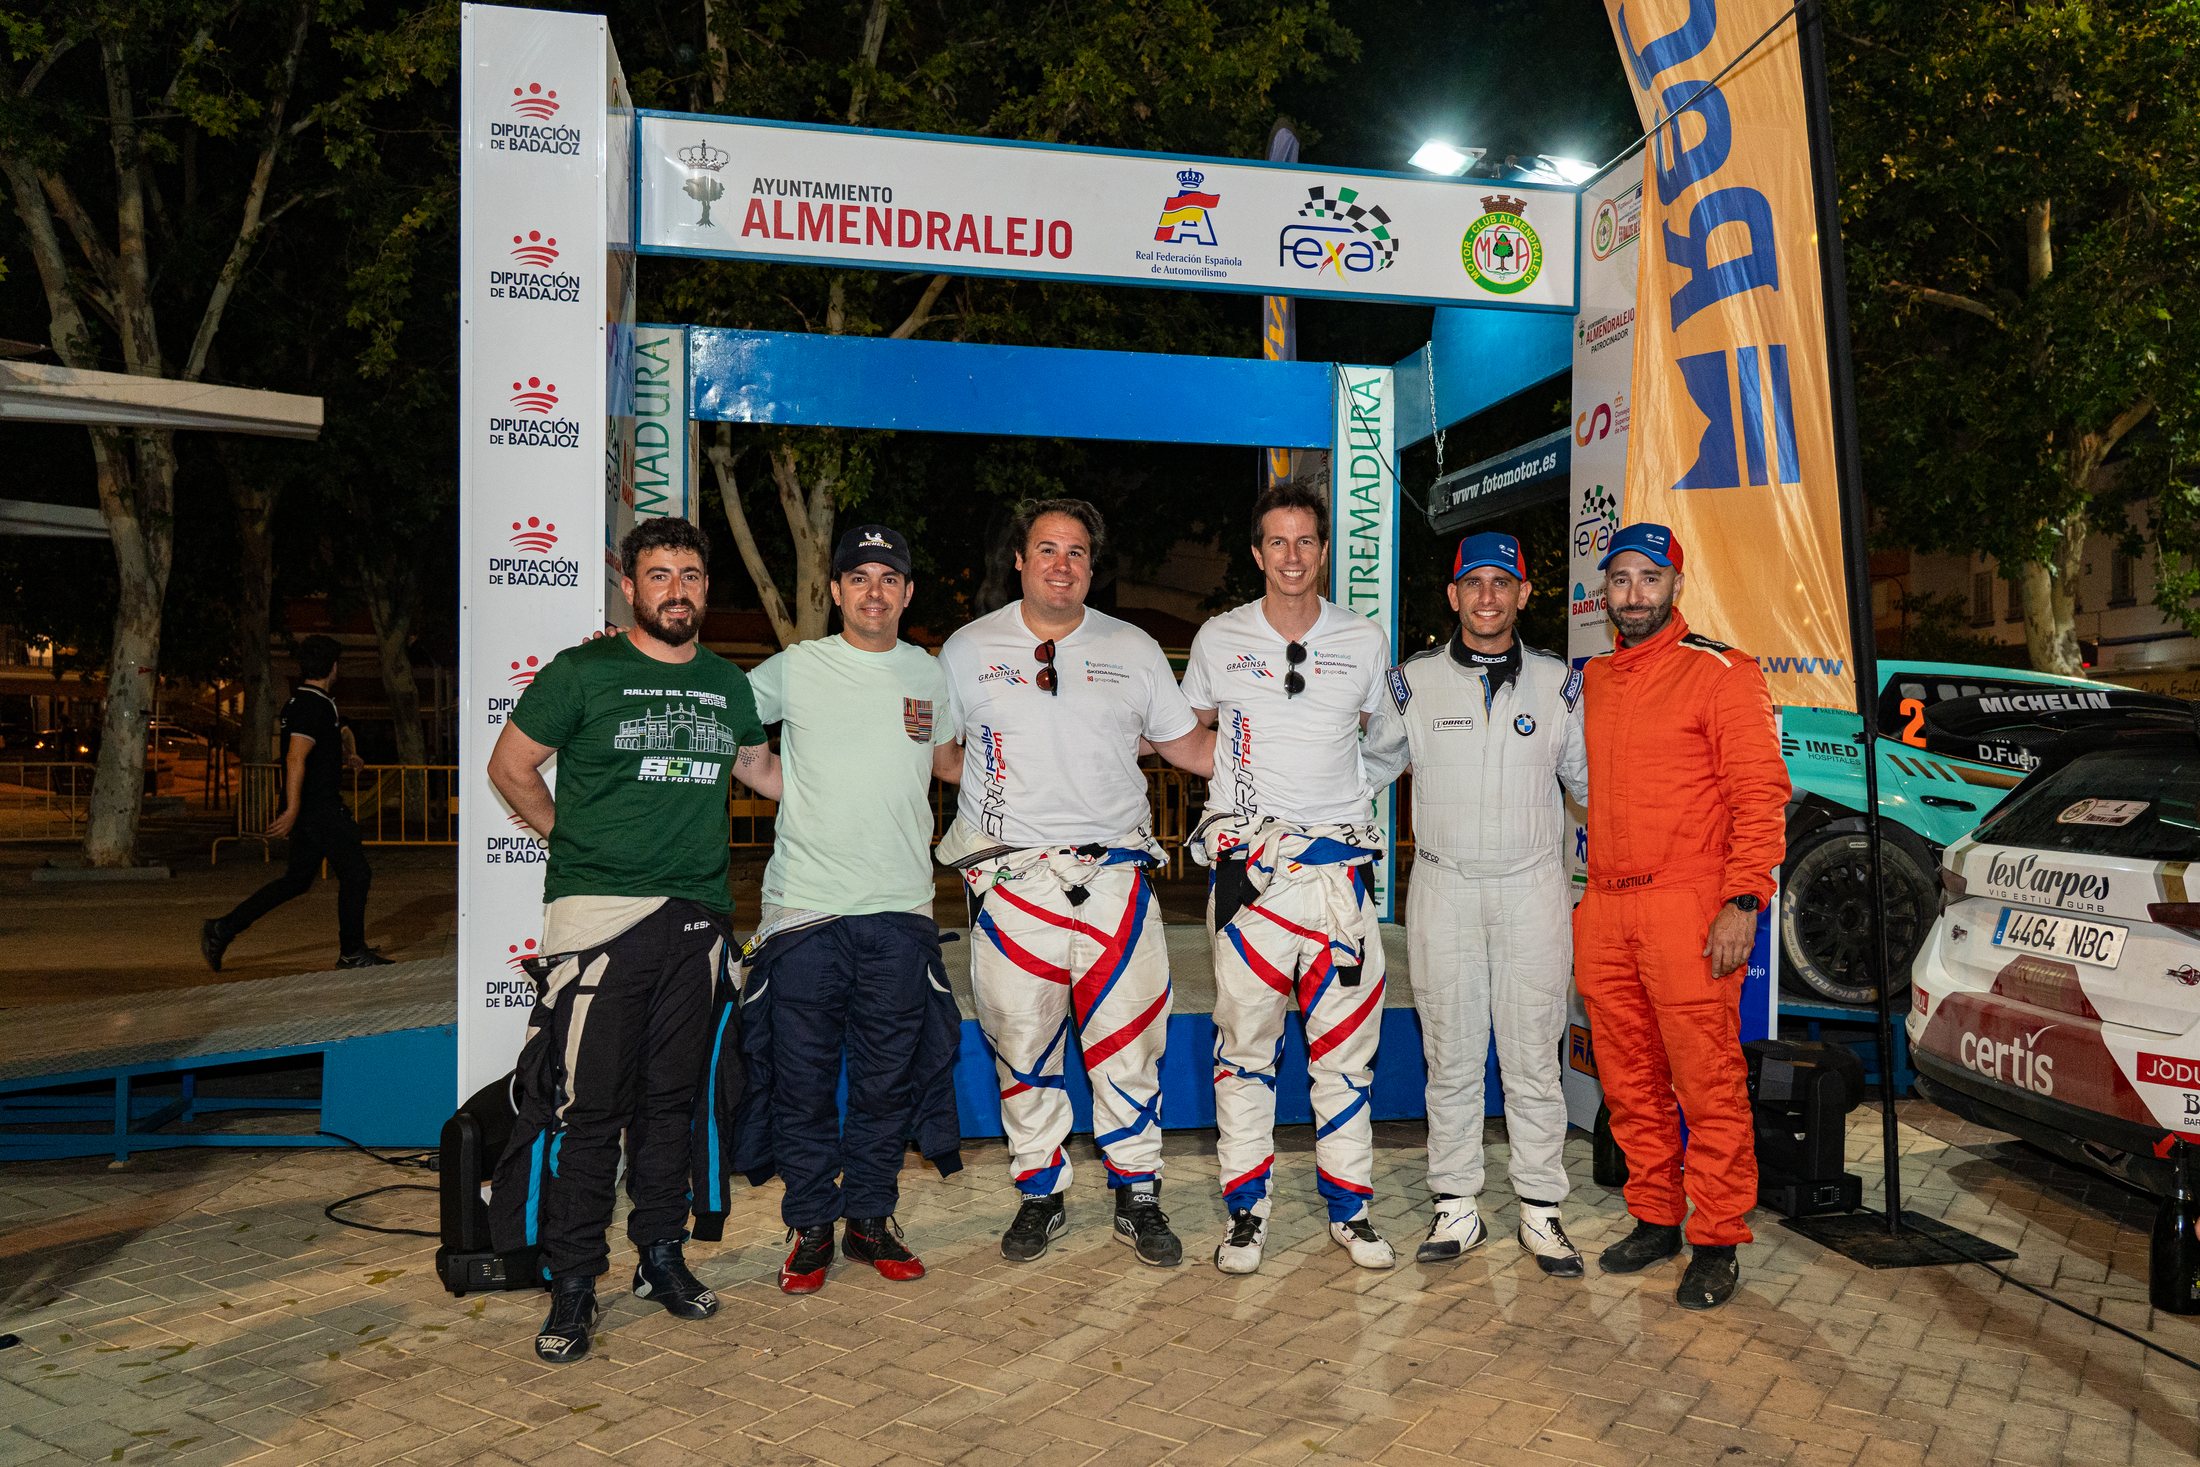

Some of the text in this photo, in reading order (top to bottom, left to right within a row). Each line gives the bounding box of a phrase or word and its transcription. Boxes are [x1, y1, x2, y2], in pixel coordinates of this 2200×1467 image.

[490, 122, 581, 143] DIPUTACIÓN
[490, 138, 580, 156] DE BADAJOZ
[752, 177, 893, 203] AYUNTAMIENTO
[741, 198, 1073, 259] ALMENDRALEJO
[1135, 250, 1242, 267] Real Federación Española
[1280, 224, 1374, 285] fexa
[1463, 241, 1480, 281] MOTOR
[1472, 216, 1497, 234] CLUB
[1499, 214, 1540, 285] ALMENDRALEJO
[490, 271, 580, 289] DIPUTACIÓN
[1151, 264, 1228, 278] de Automovilismo
[490, 286, 580, 303] DE BADAJOZ
[1585, 307, 1635, 346] ALMENDRALEJO
[1590, 328, 1629, 354] PATROCINADOR
[490, 417, 580, 435] DIPUTACIÓN
[635, 336, 670, 516] MADURA
[489, 433, 579, 448] DE BADAJOZ
[1348, 376, 1382, 619] TREMADURA
[858, 541, 893, 550] MICHELIN
[489, 556, 579, 574] DIPUTACIÓN
[489, 572, 578, 587] DE BADAJOZ
[1572, 597, 1608, 615] BARRAG
[1226, 660, 1267, 671] GRAGINSA
[1471, 654, 1508, 664] sparco
[978, 669, 1021, 682] GRAGINSA
[665, 689, 684, 697] DEL
[686, 690, 726, 702] COMERCIO
[1978, 692, 2111, 714] MICHELIN
[487, 714, 502, 724] DE
[1899, 697, 1927, 749] 2
[1241, 717, 1252, 769] Team
[1805, 740, 1859, 758] IMED
[993, 731, 1007, 783] Team
[1808, 753, 1862, 766] HOSPITALES
[1978, 744, 2042, 769] D.Fuen
[487, 837, 549, 850] DIPUTAC
[487, 851, 547, 864] DE BADA
[1616, 874, 1653, 889] CASTILLA
[1988, 889, 2105, 913] VIG ESTIU GURB
[1996, 914, 2114, 961] E 4464 NBC
[486, 982, 539, 995] DIPUTA
[485, 998, 500, 1008] DE
[1960, 1025, 2057, 1096] certis
